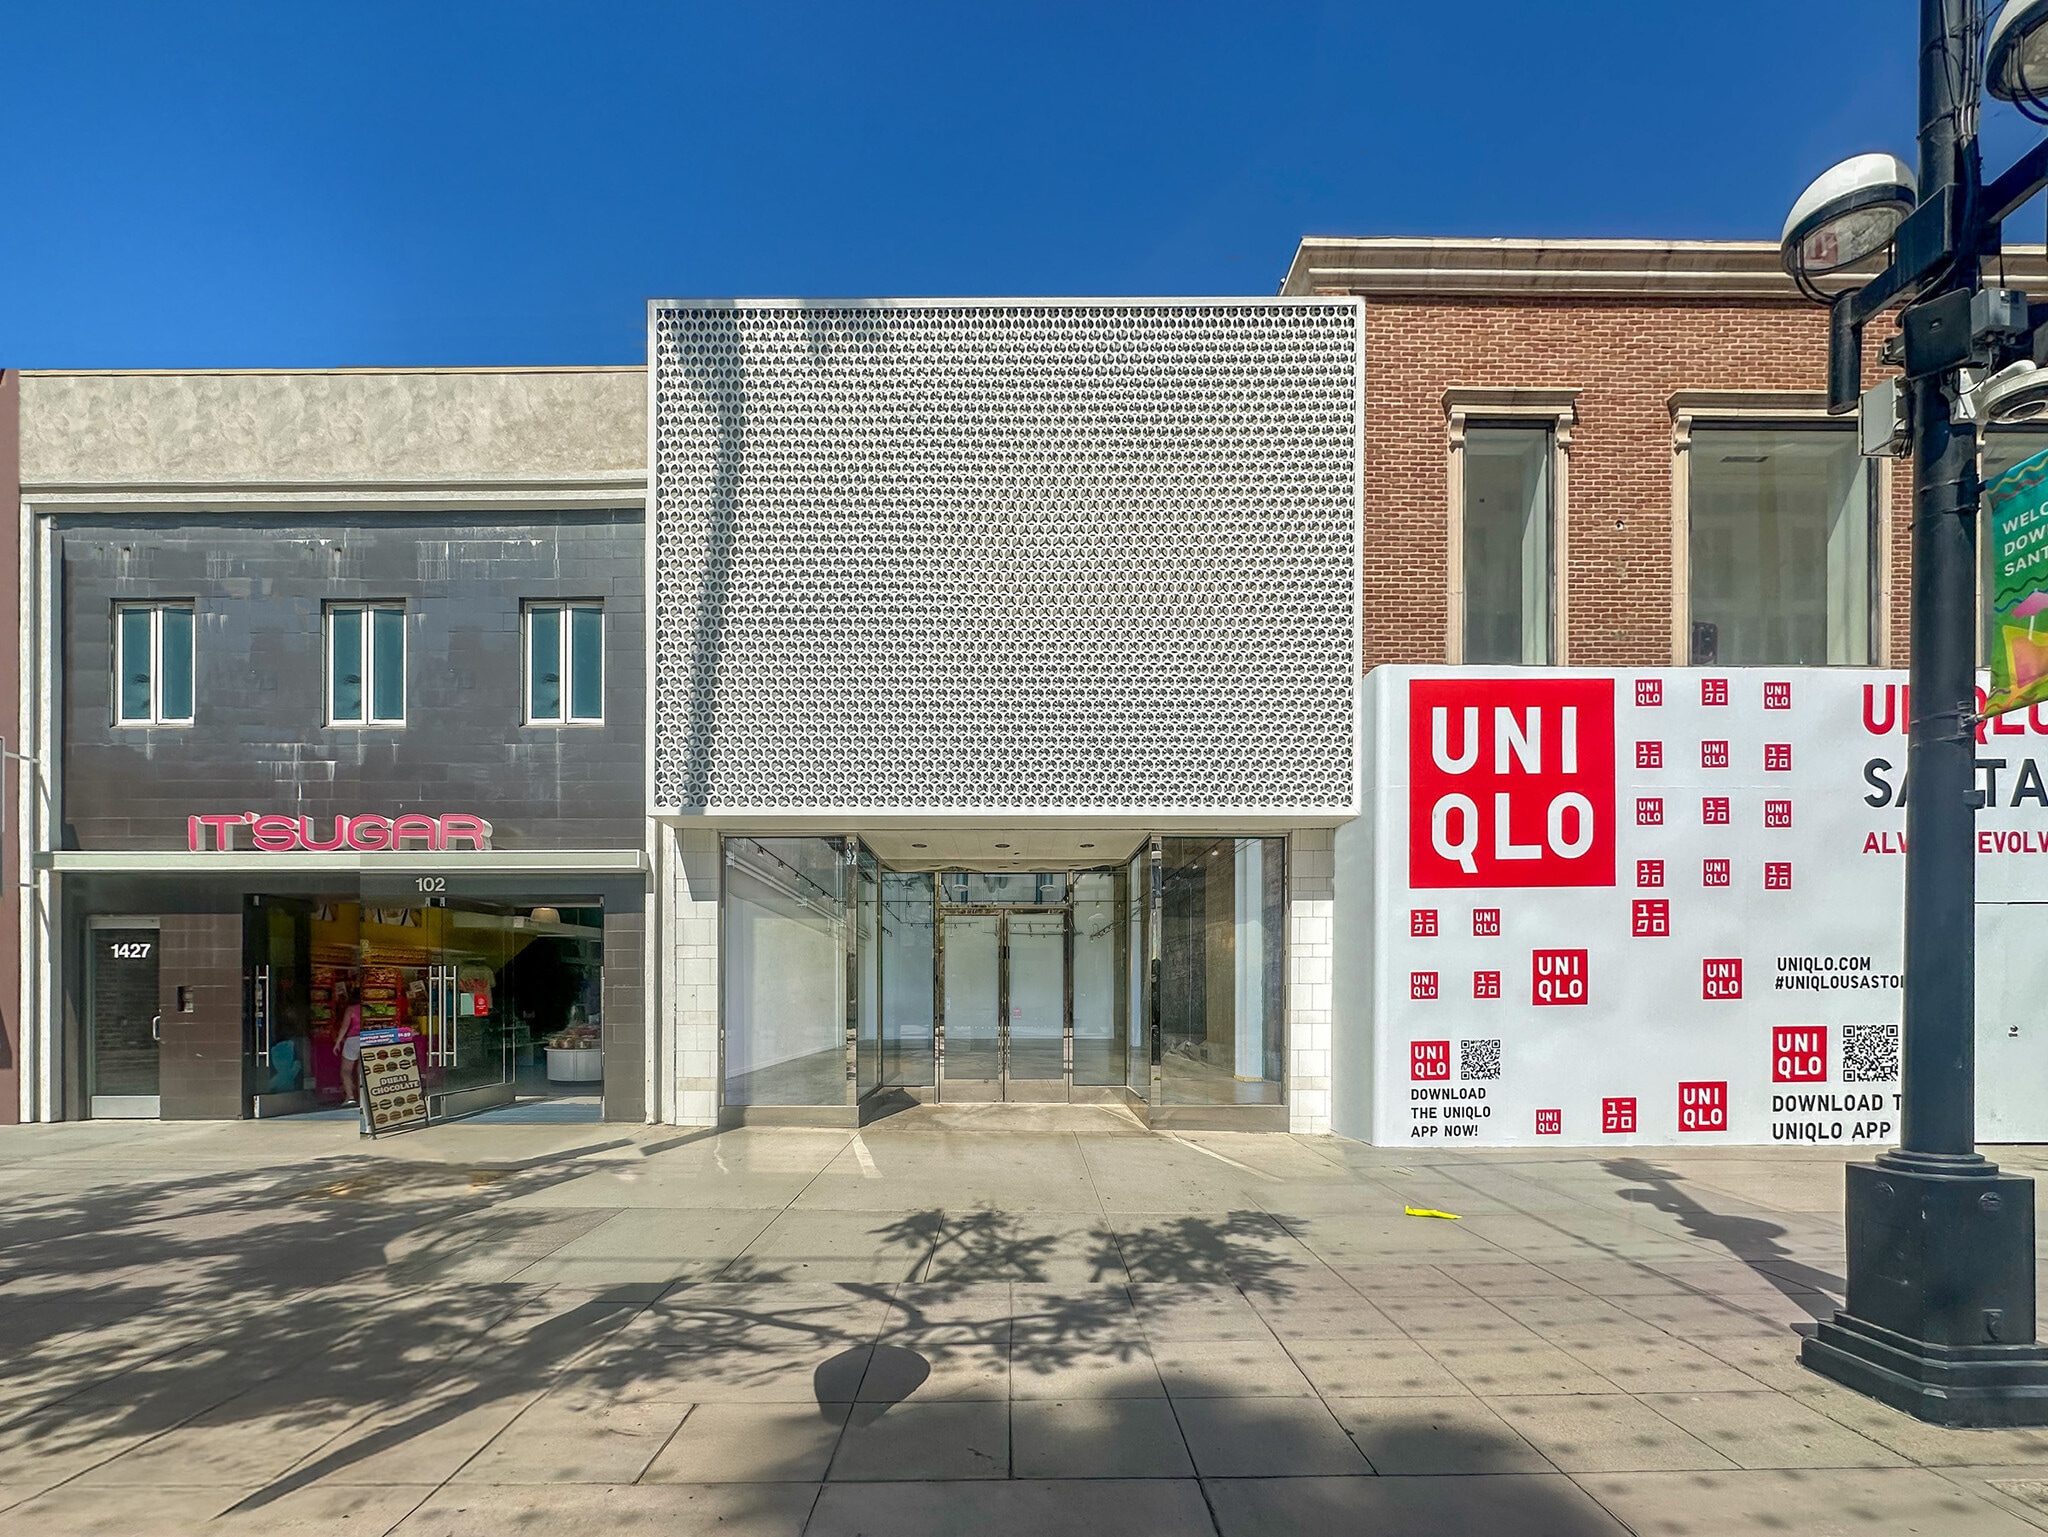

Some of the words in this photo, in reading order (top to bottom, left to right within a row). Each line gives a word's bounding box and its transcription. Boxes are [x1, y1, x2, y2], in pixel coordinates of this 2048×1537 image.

[2004, 523, 2048, 557] DOW
[1638, 683, 1659, 692] UNI
[1767, 686, 1787, 695] UNI
[1638, 694, 1661, 704] QLO
[1767, 697, 1789, 707] QLO
[1432, 707, 1577, 774] UNI
[1704, 744, 1724, 753] UNI
[1704, 755, 1727, 765] QLO
[1863, 757, 2048, 808] STA
[1639, 802, 1659, 810] UNI
[1768, 804, 1787, 813] UNI
[1639, 813, 1661, 823] QLO
[1768, 815, 1790, 825] QLO
[188, 811, 489, 851] IT'SUGAR
[1432, 792, 1593, 873] QLO
[1706, 863, 1726, 872] UNI
[415, 877, 446, 892] 102
[1706, 874, 1728, 884] QLO
[1476, 912, 1496, 921] UNI
[1476, 924, 1498, 934] QLO
[110, 943, 151, 959] 1427
[1539, 957, 1578, 975] UNI
[1707, 964, 1736, 977] UNI
[1777, 957, 1871, 973] UNIQLO.COM
[1414, 976, 1434, 984] UNI
[1775, 975, 1904, 991] #UNIQLOUSASTO
[1414, 987, 1436, 997] QLO
[1539, 980, 1582, 1001] QLO
[1707, 981, 1739, 996] QLO
[1779, 1034, 1817, 1052] UNI
[1415, 1046, 1443, 1059] UNI
[1415, 1062, 1447, 1078] QLO
[1778, 1057, 1821, 1078] QLO
[380, 1075, 407, 1086] DUBAI
[371, 1081, 419, 1095] CHOCOLATE
[1411, 1087, 1486, 1100] DOWNLOAD
[1684, 1088, 1719, 1105] UNI
[1772, 1094, 1883, 1112] DOWNLOAD
[1411, 1107, 1437, 1119] THE
[1443, 1106, 1491, 1120] UNIQLO
[1539, 1112, 1557, 1121] UNI
[1684, 1109, 1723, 1128] QLO
[1411, 1125, 1438, 1138] APP
[1444, 1125, 1478, 1137] NOW!
[1539, 1123, 1559, 1132] QLO
[1772, 1122, 1842, 1142] UNIQLO
[1851, 1121, 1891, 1139] APP
